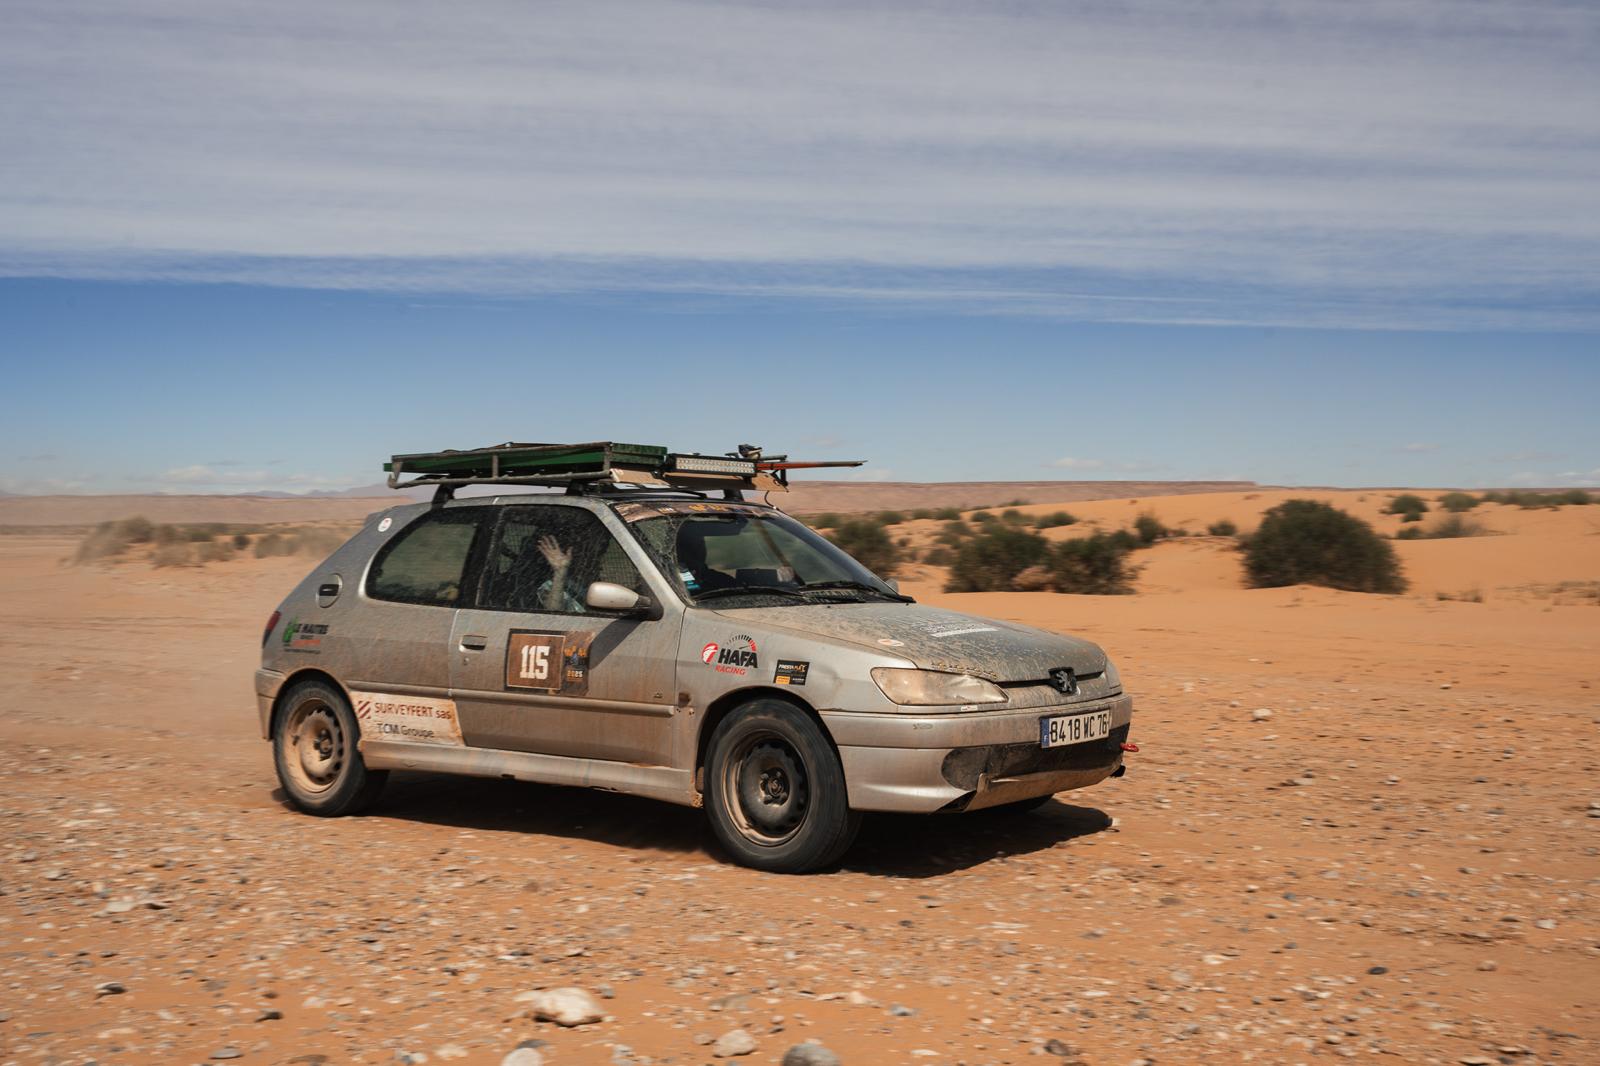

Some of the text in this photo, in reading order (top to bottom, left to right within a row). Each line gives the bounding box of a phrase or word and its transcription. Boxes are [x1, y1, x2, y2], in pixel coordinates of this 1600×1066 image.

[520, 645, 550, 680] 115
[717, 648, 758, 669] HAFA
[715, 665, 746, 676] RACING
[375, 702, 452, 720] SURVEYFERT sas
[377, 723, 435, 738] TCM Groupe
[1050, 719, 1081, 743] 8418
[1097, 713, 1108, 735] 76
